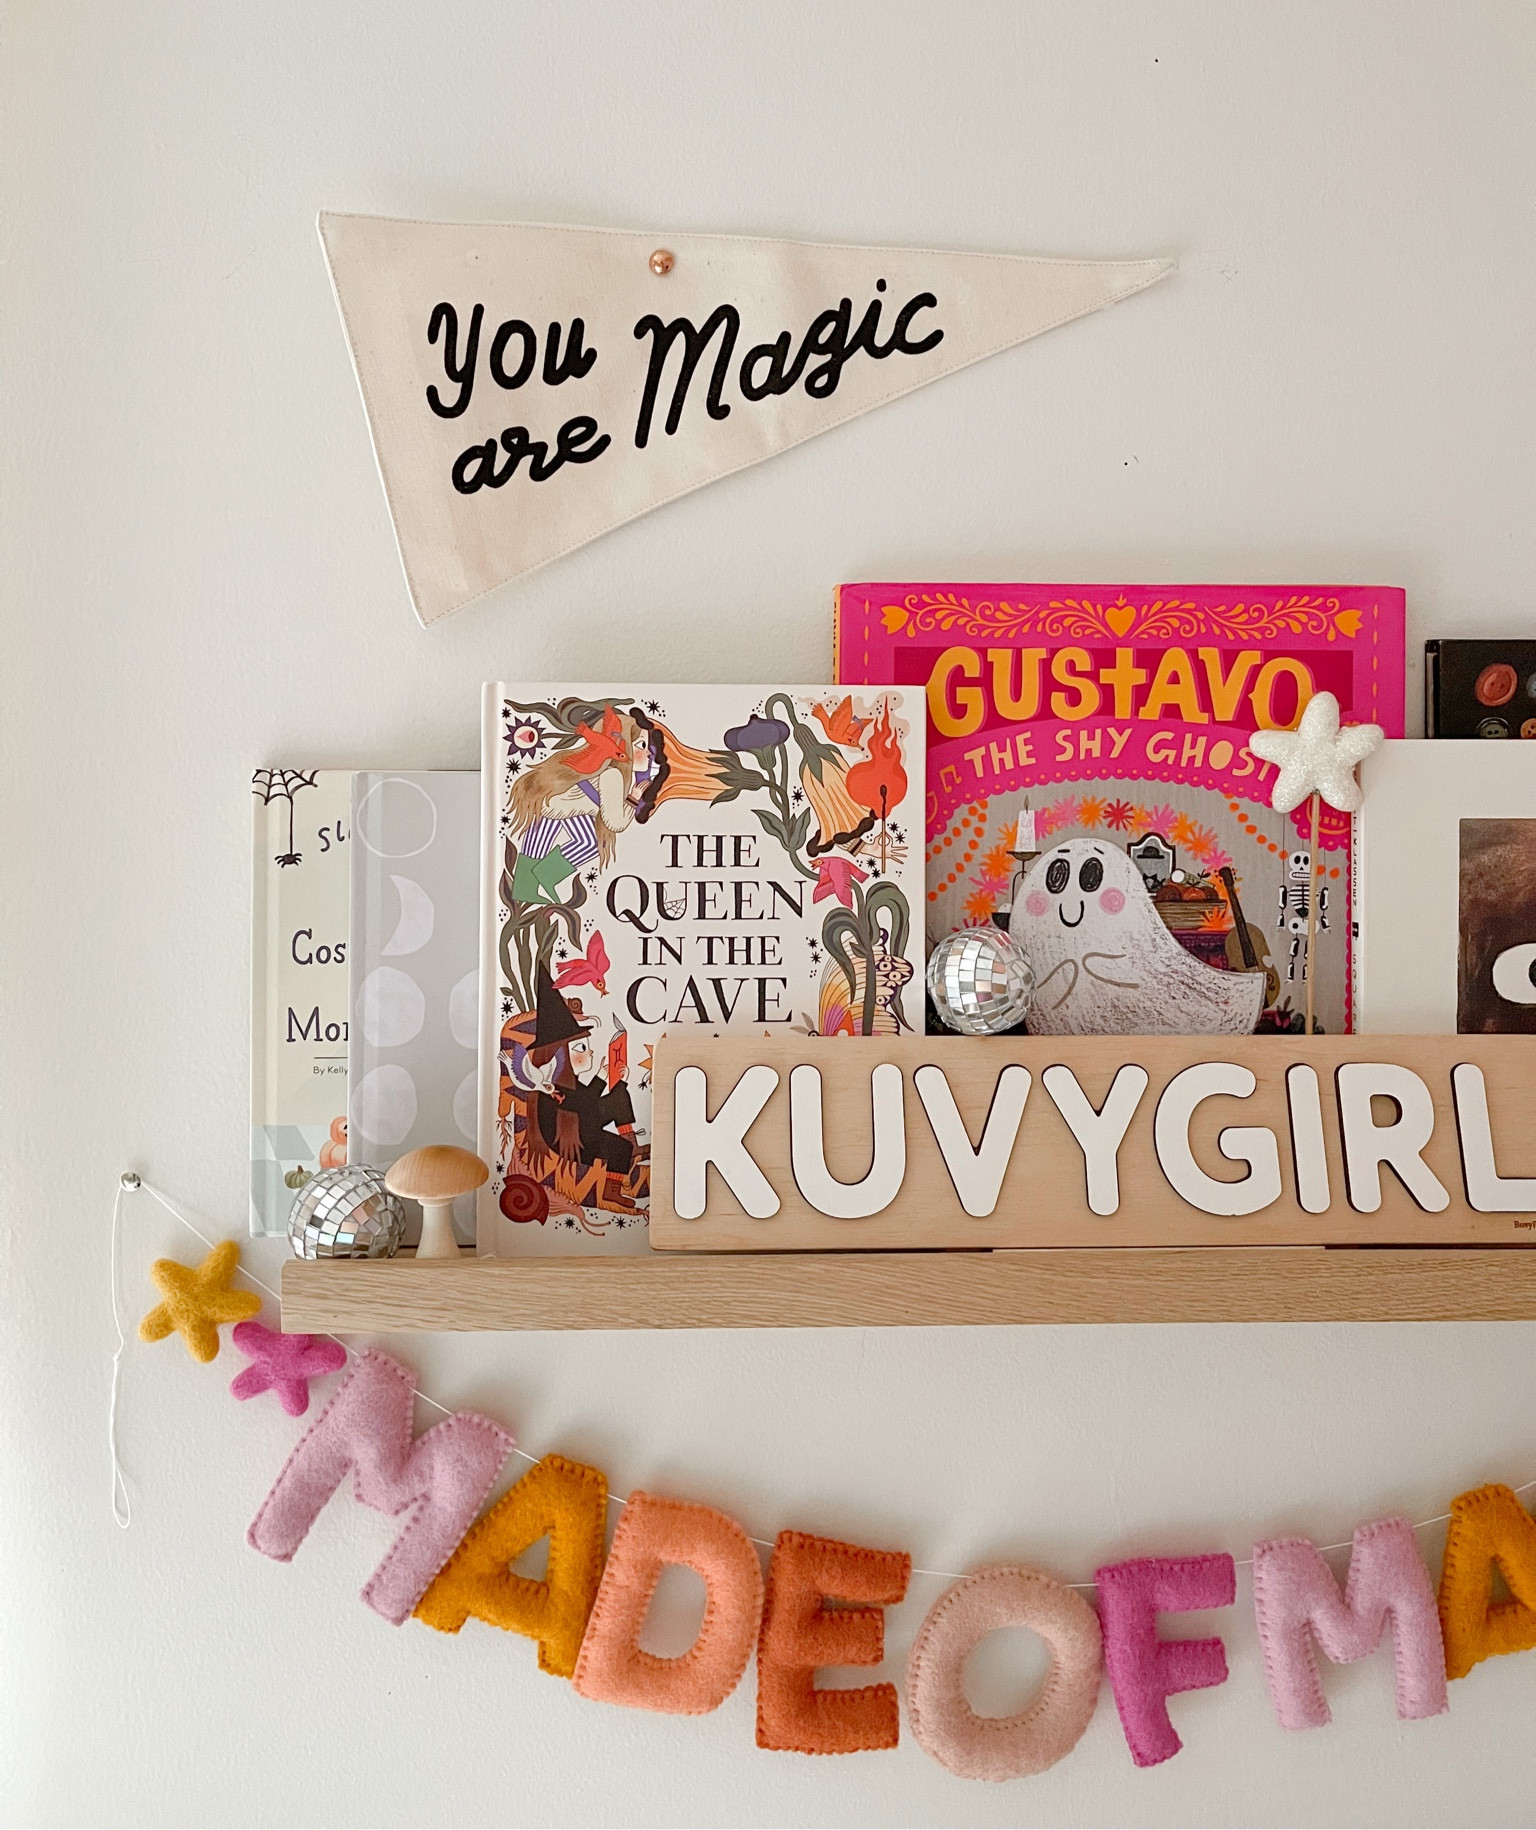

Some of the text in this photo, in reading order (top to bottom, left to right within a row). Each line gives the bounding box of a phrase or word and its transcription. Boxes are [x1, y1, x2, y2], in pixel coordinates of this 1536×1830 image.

[427, 278, 944, 449] You Magic
[451, 415, 612, 494] are
[927, 647, 1314, 738] GUSTAVO
[964, 731, 1036, 778] THE
[1055, 727, 1133, 762] SHY
[318, 820, 350, 852] Sl
[659, 834, 761, 868] THE
[606, 874, 807, 934] QUEEN
[638, 935, 783, 966] IN THE
[626, 975, 793, 1025] CAVE
[313, 1066, 348, 1076] By Kelly
[673, 1063, 1536, 1219] KUVYGIRL
